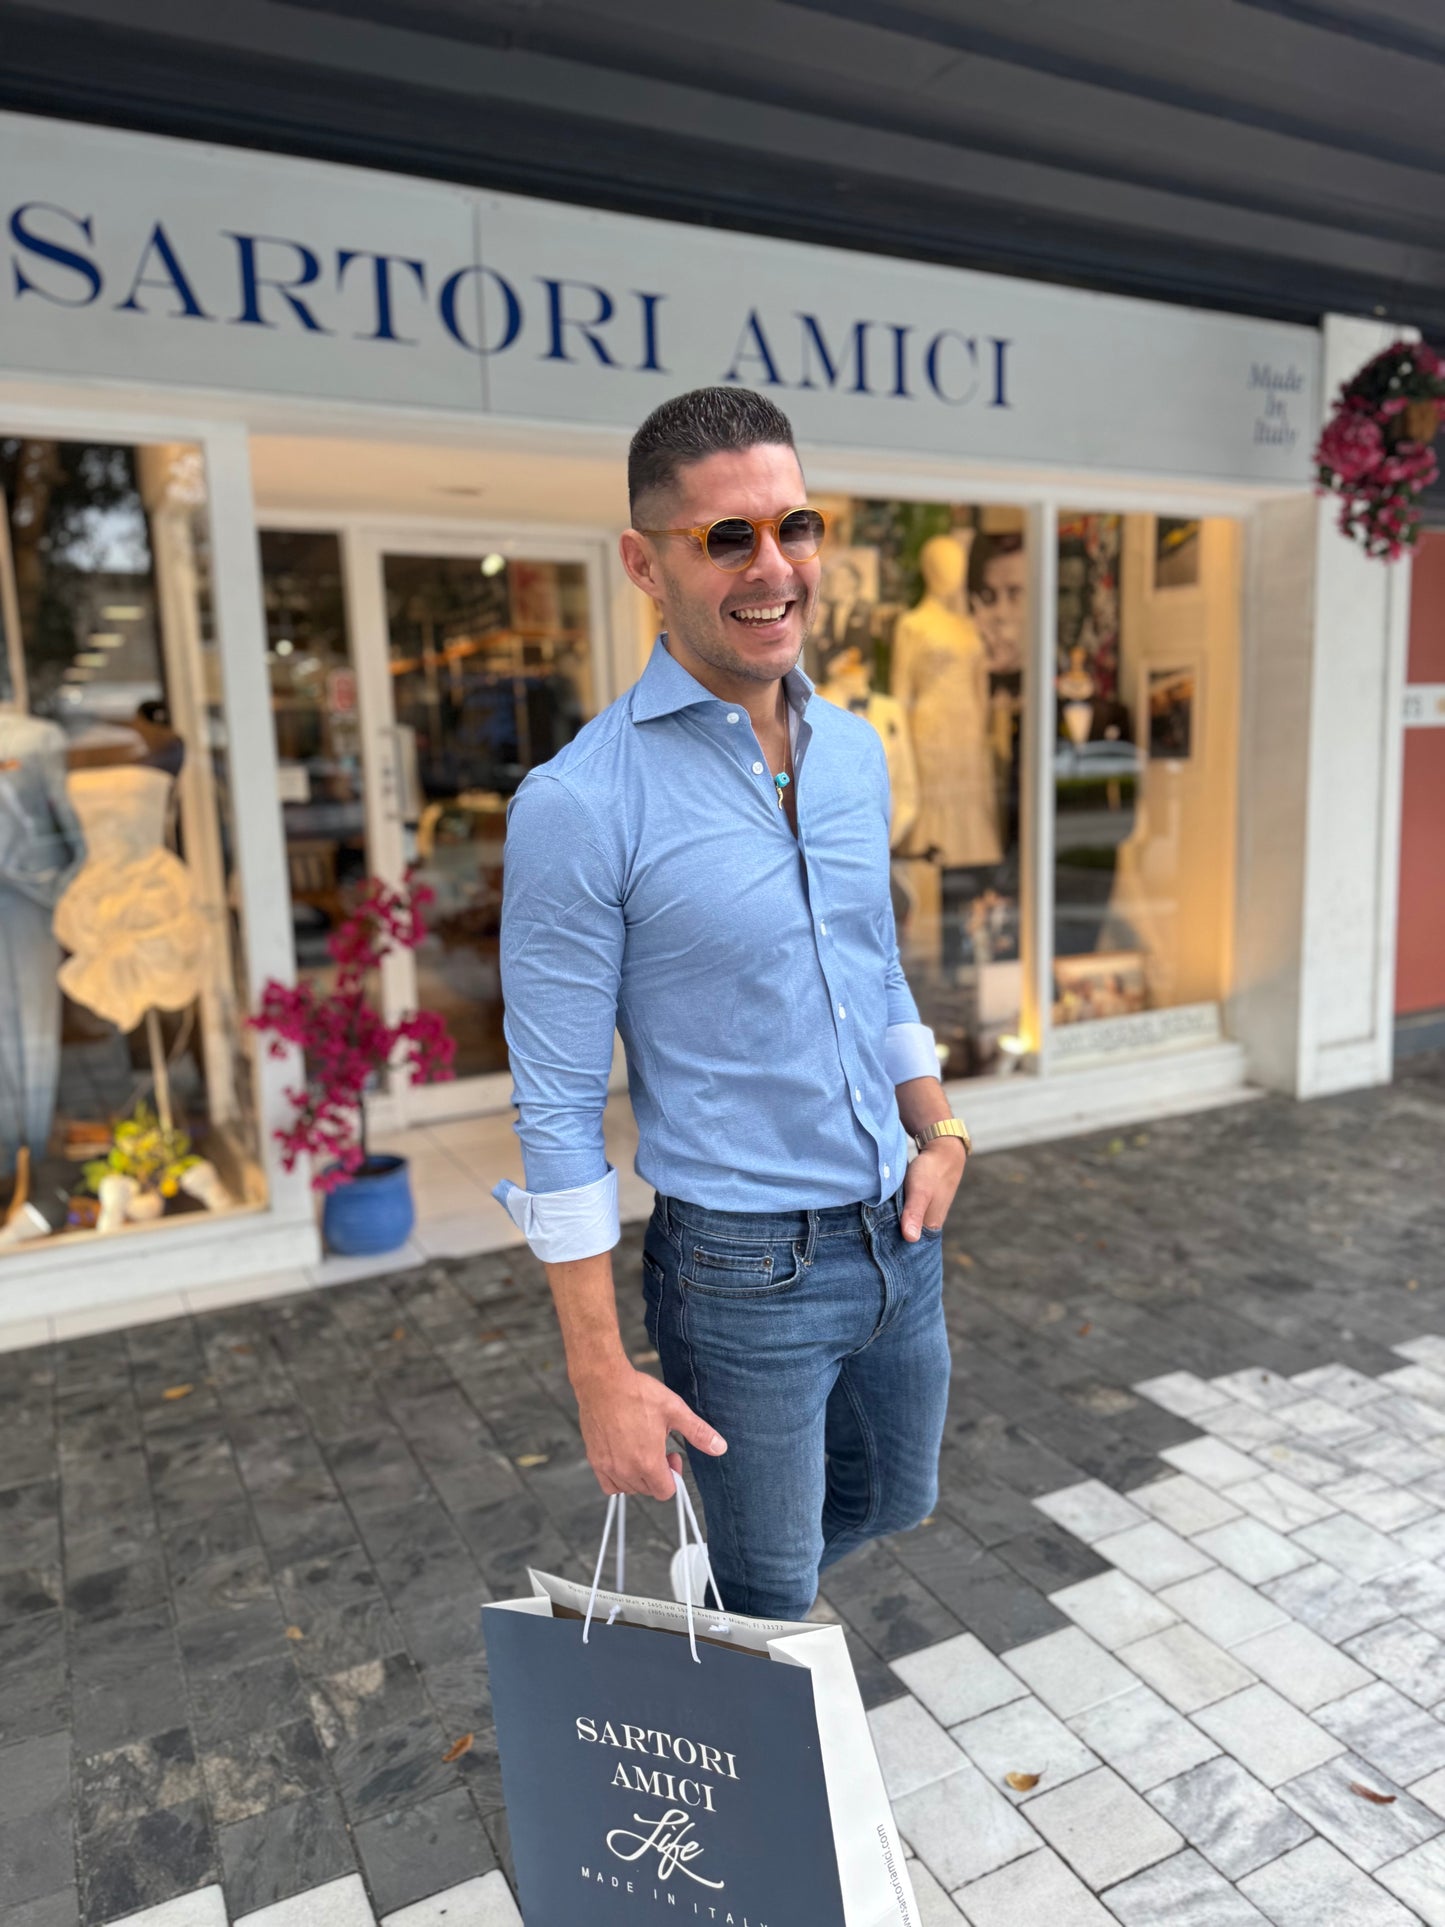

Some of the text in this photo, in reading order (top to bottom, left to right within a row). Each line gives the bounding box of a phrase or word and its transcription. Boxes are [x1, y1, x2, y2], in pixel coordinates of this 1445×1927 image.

[9, 201, 1014, 409] SARTORI AMICI
[1247, 362, 1305, 394] Made
[576, 1716, 741, 1780] SARTORI
[610, 1762, 717, 1812] AMICI
[606, 1809, 725, 1889] Life
[581, 1866, 634, 1893] MADE
[653, 1889, 676, 1906] IN
